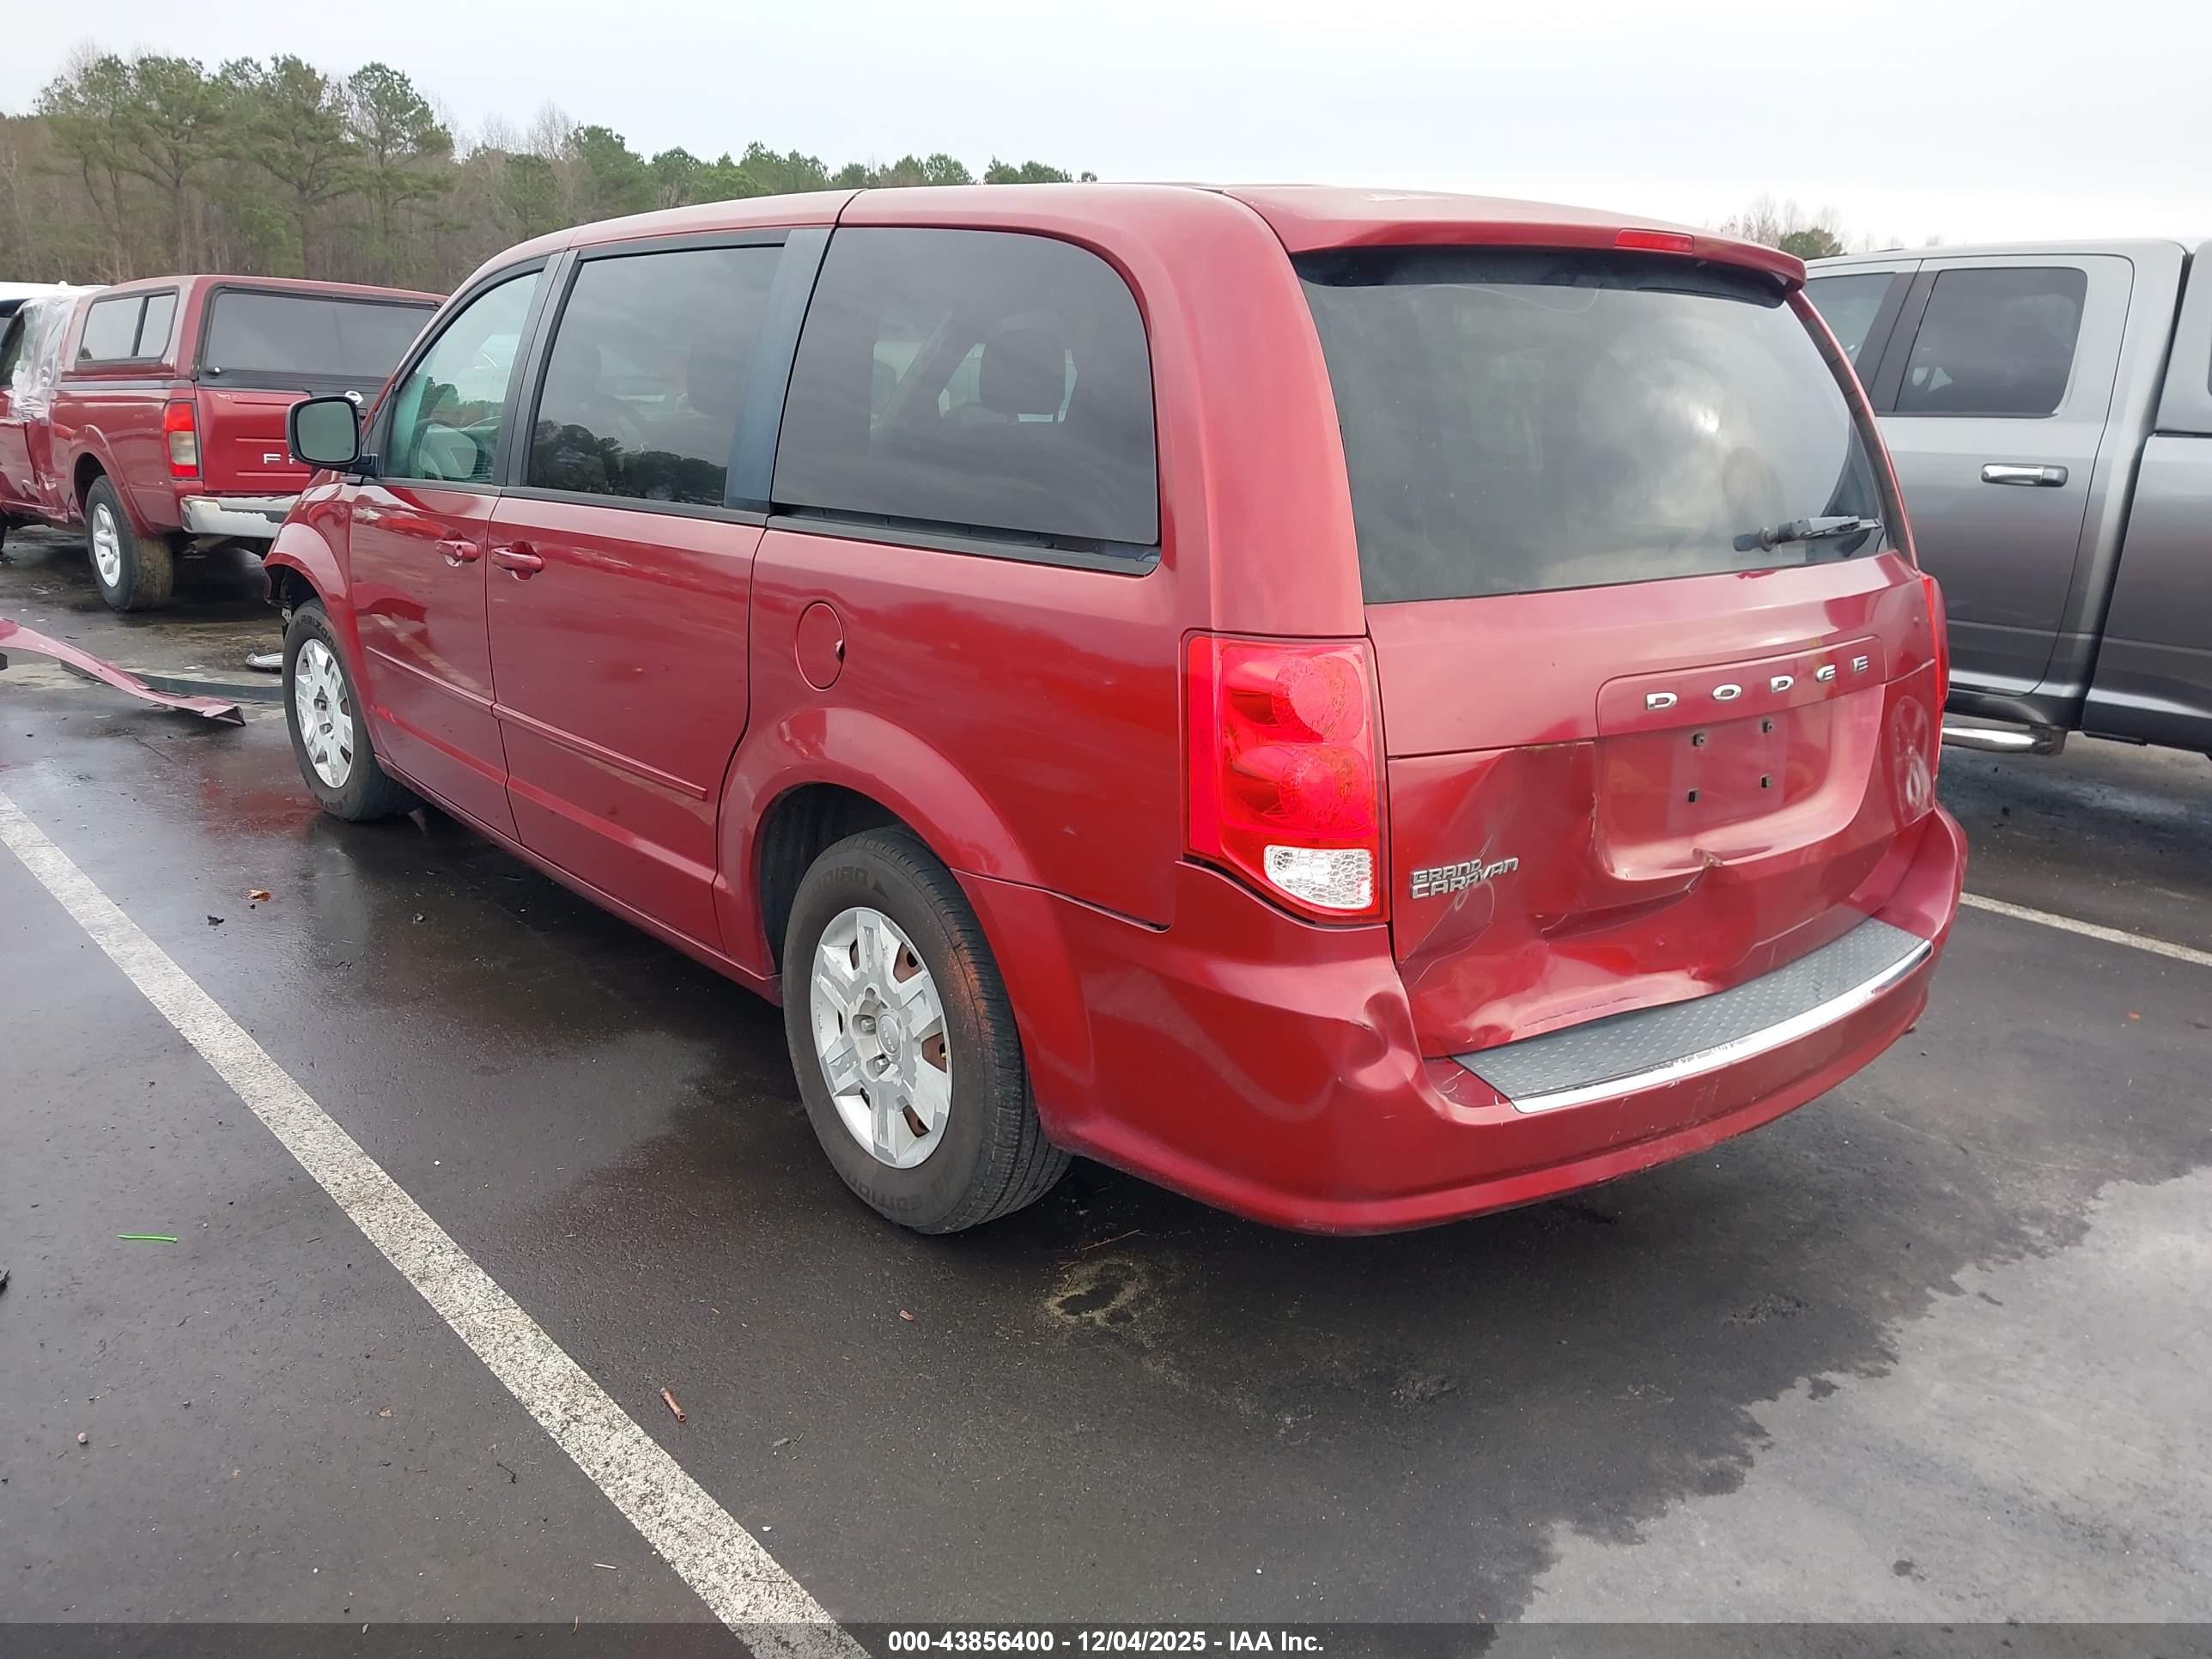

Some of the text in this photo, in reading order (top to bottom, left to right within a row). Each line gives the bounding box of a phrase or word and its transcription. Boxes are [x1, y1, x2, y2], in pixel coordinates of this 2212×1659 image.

[1645, 654, 1869, 711] DODGE
[1412, 857, 1520, 899] CARAVAN
[1413, 859, 1482, 884] GRAND
